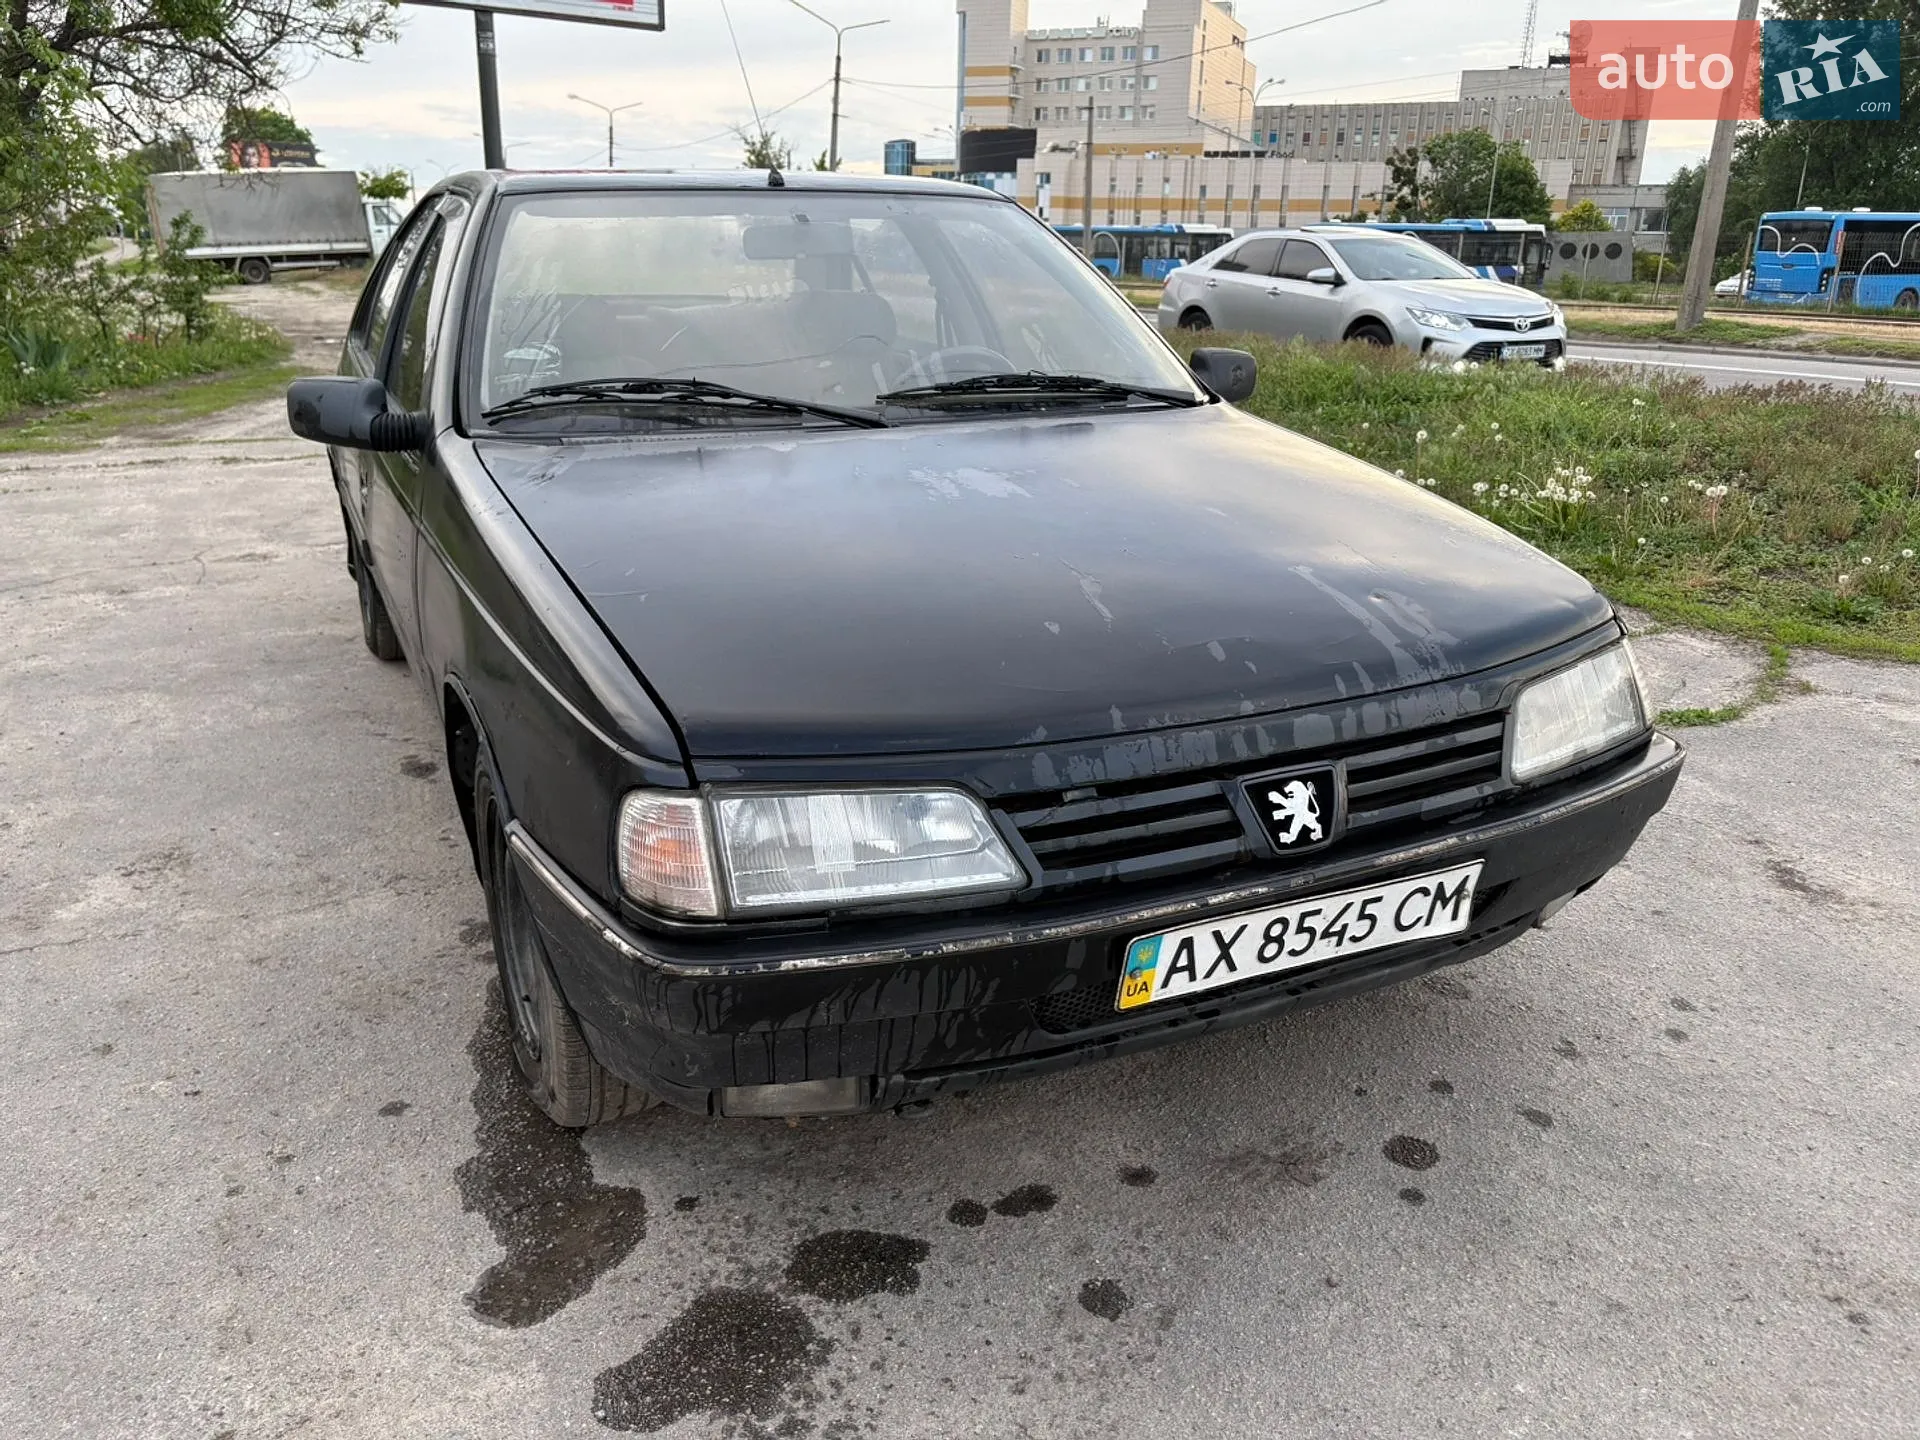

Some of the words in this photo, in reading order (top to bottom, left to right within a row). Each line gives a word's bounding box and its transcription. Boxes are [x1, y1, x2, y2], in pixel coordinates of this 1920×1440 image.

[1160, 924, 1248, 990] AX
[1256, 895, 1385, 965] 8545
[1394, 874, 1471, 932] CM
[1126, 979, 1151, 998] UA
